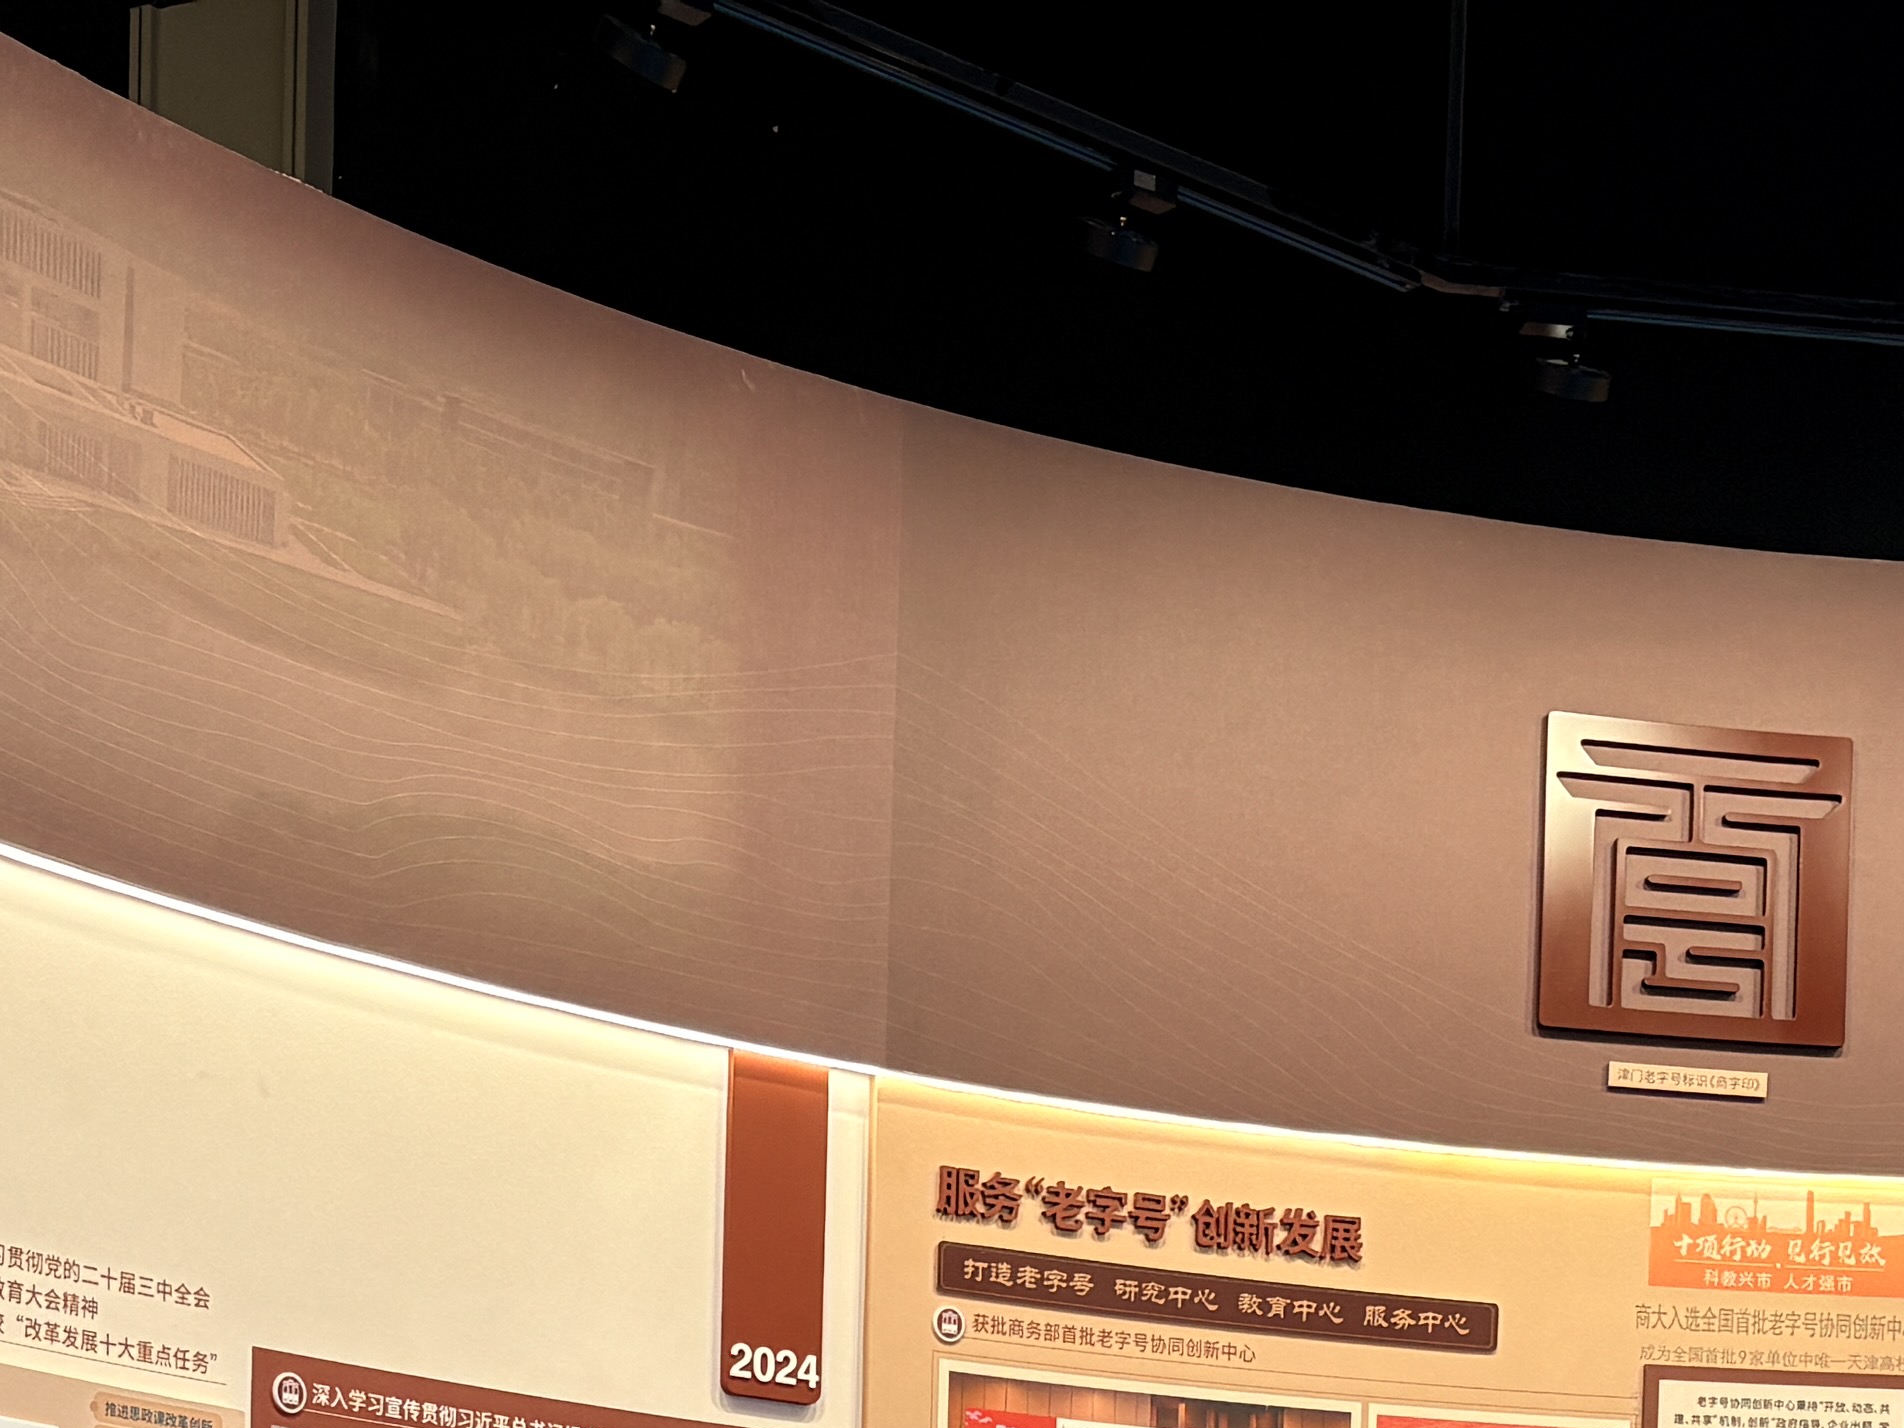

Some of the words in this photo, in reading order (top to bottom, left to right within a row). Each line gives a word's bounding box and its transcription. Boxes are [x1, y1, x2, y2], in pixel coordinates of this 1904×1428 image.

[938, 1165, 1364, 1262] 服务“老字号”创新发展
[1674, 1234, 1771, 1262] 十项行动
[964, 1259, 1094, 1295] 打造老字号
[1114, 1279, 1218, 1311] 研究中心
[1238, 1292, 1344, 1324] 教育中心
[1364, 1305, 1470, 1335] 服务中心
[1703, 1269, 1772, 1289] 科教兴市
[1784, 1273, 1853, 1293] 人才强市
[15, 1312, 218, 1375] “改革发展十大重点任务”
[972, 1313, 1255, 1364] 获批商务部首批老字号协同创新中心
[730, 1343, 819, 1389] 2024
